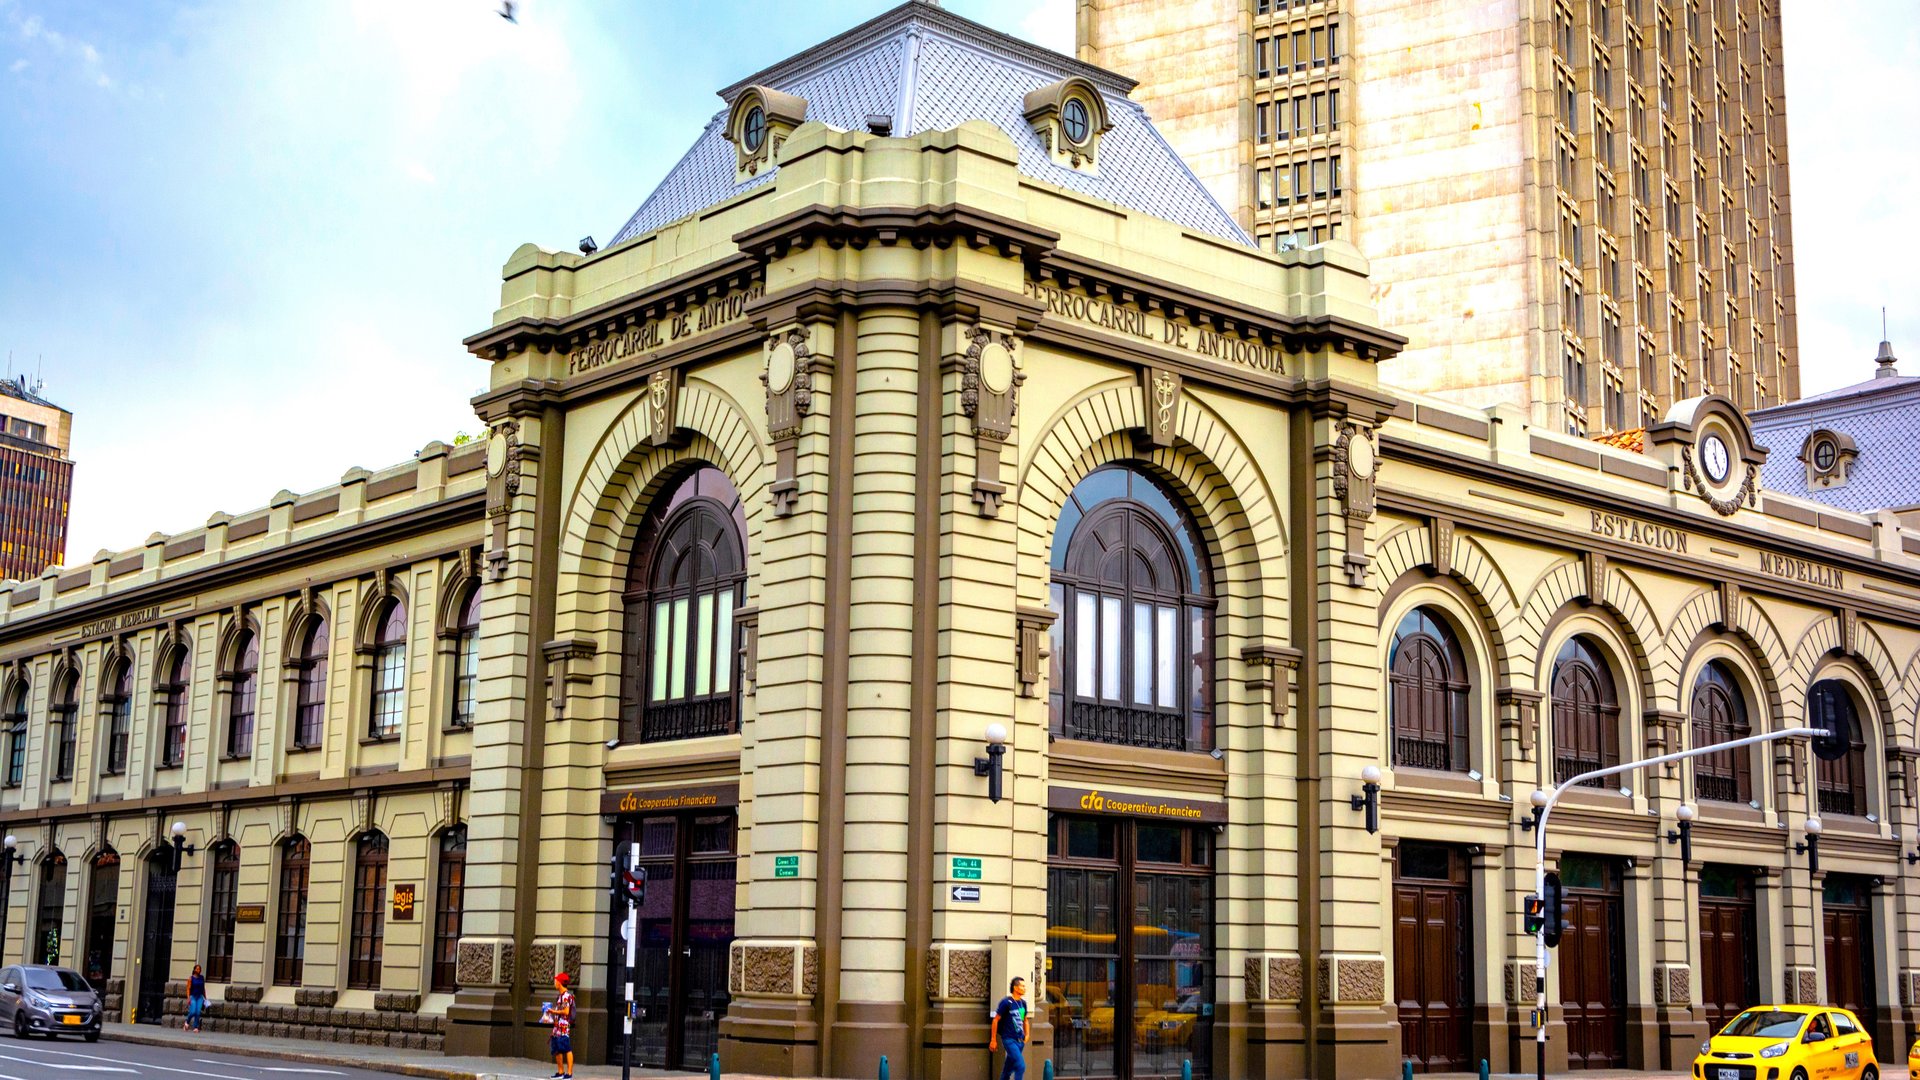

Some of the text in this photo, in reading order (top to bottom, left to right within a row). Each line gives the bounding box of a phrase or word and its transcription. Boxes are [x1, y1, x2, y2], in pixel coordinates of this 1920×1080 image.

[569, 323, 664, 375] FERROCARRIL
[670, 312, 692, 340] DE
[1163, 319, 1188, 349] DE
[1196, 330, 1287, 375] ANTIOQUIA
[1589, 510, 1844, 590] ESTACION MEDELLIN
[81, 606, 161, 638] ESTACION MEDELLIN
[620, 792, 717, 811] cfa Cooperativa Financiera
[1080, 790, 1202, 818] cfa Cooperativa Financiera
[393, 888, 414, 906] legis
